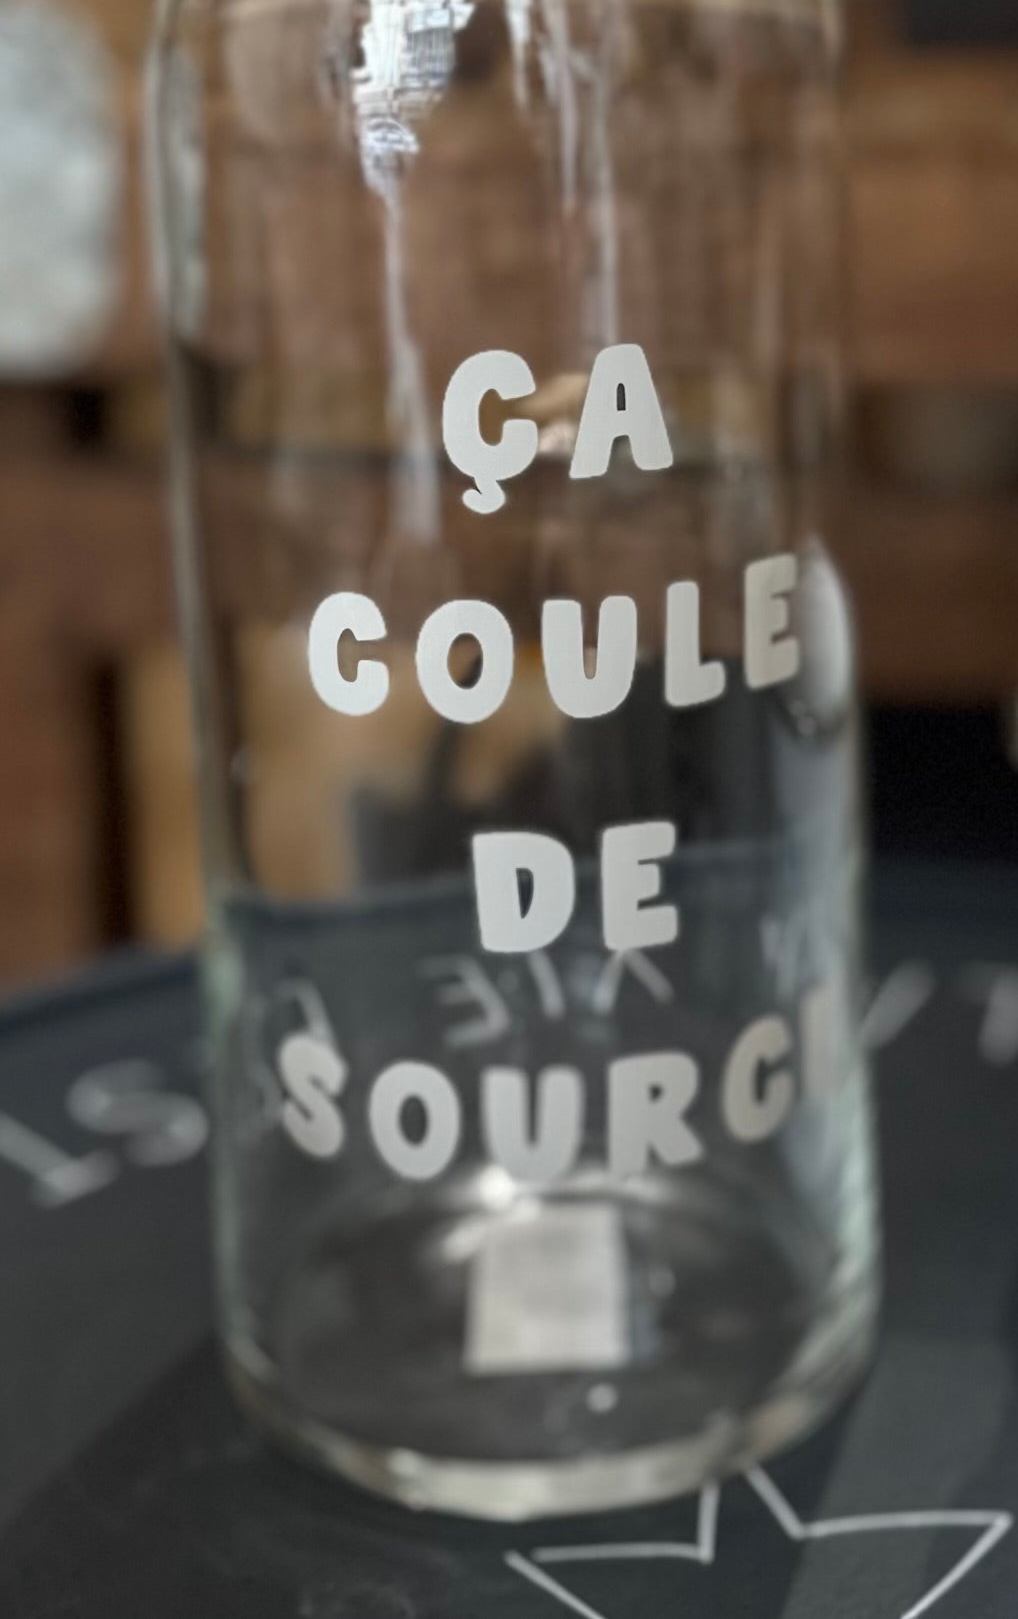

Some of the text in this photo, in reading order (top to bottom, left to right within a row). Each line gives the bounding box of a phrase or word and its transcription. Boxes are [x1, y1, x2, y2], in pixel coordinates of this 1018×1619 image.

[442, 343, 674, 514] ÇA
[308, 554, 800, 724] COULE
[471, 821, 679, 953] DE
